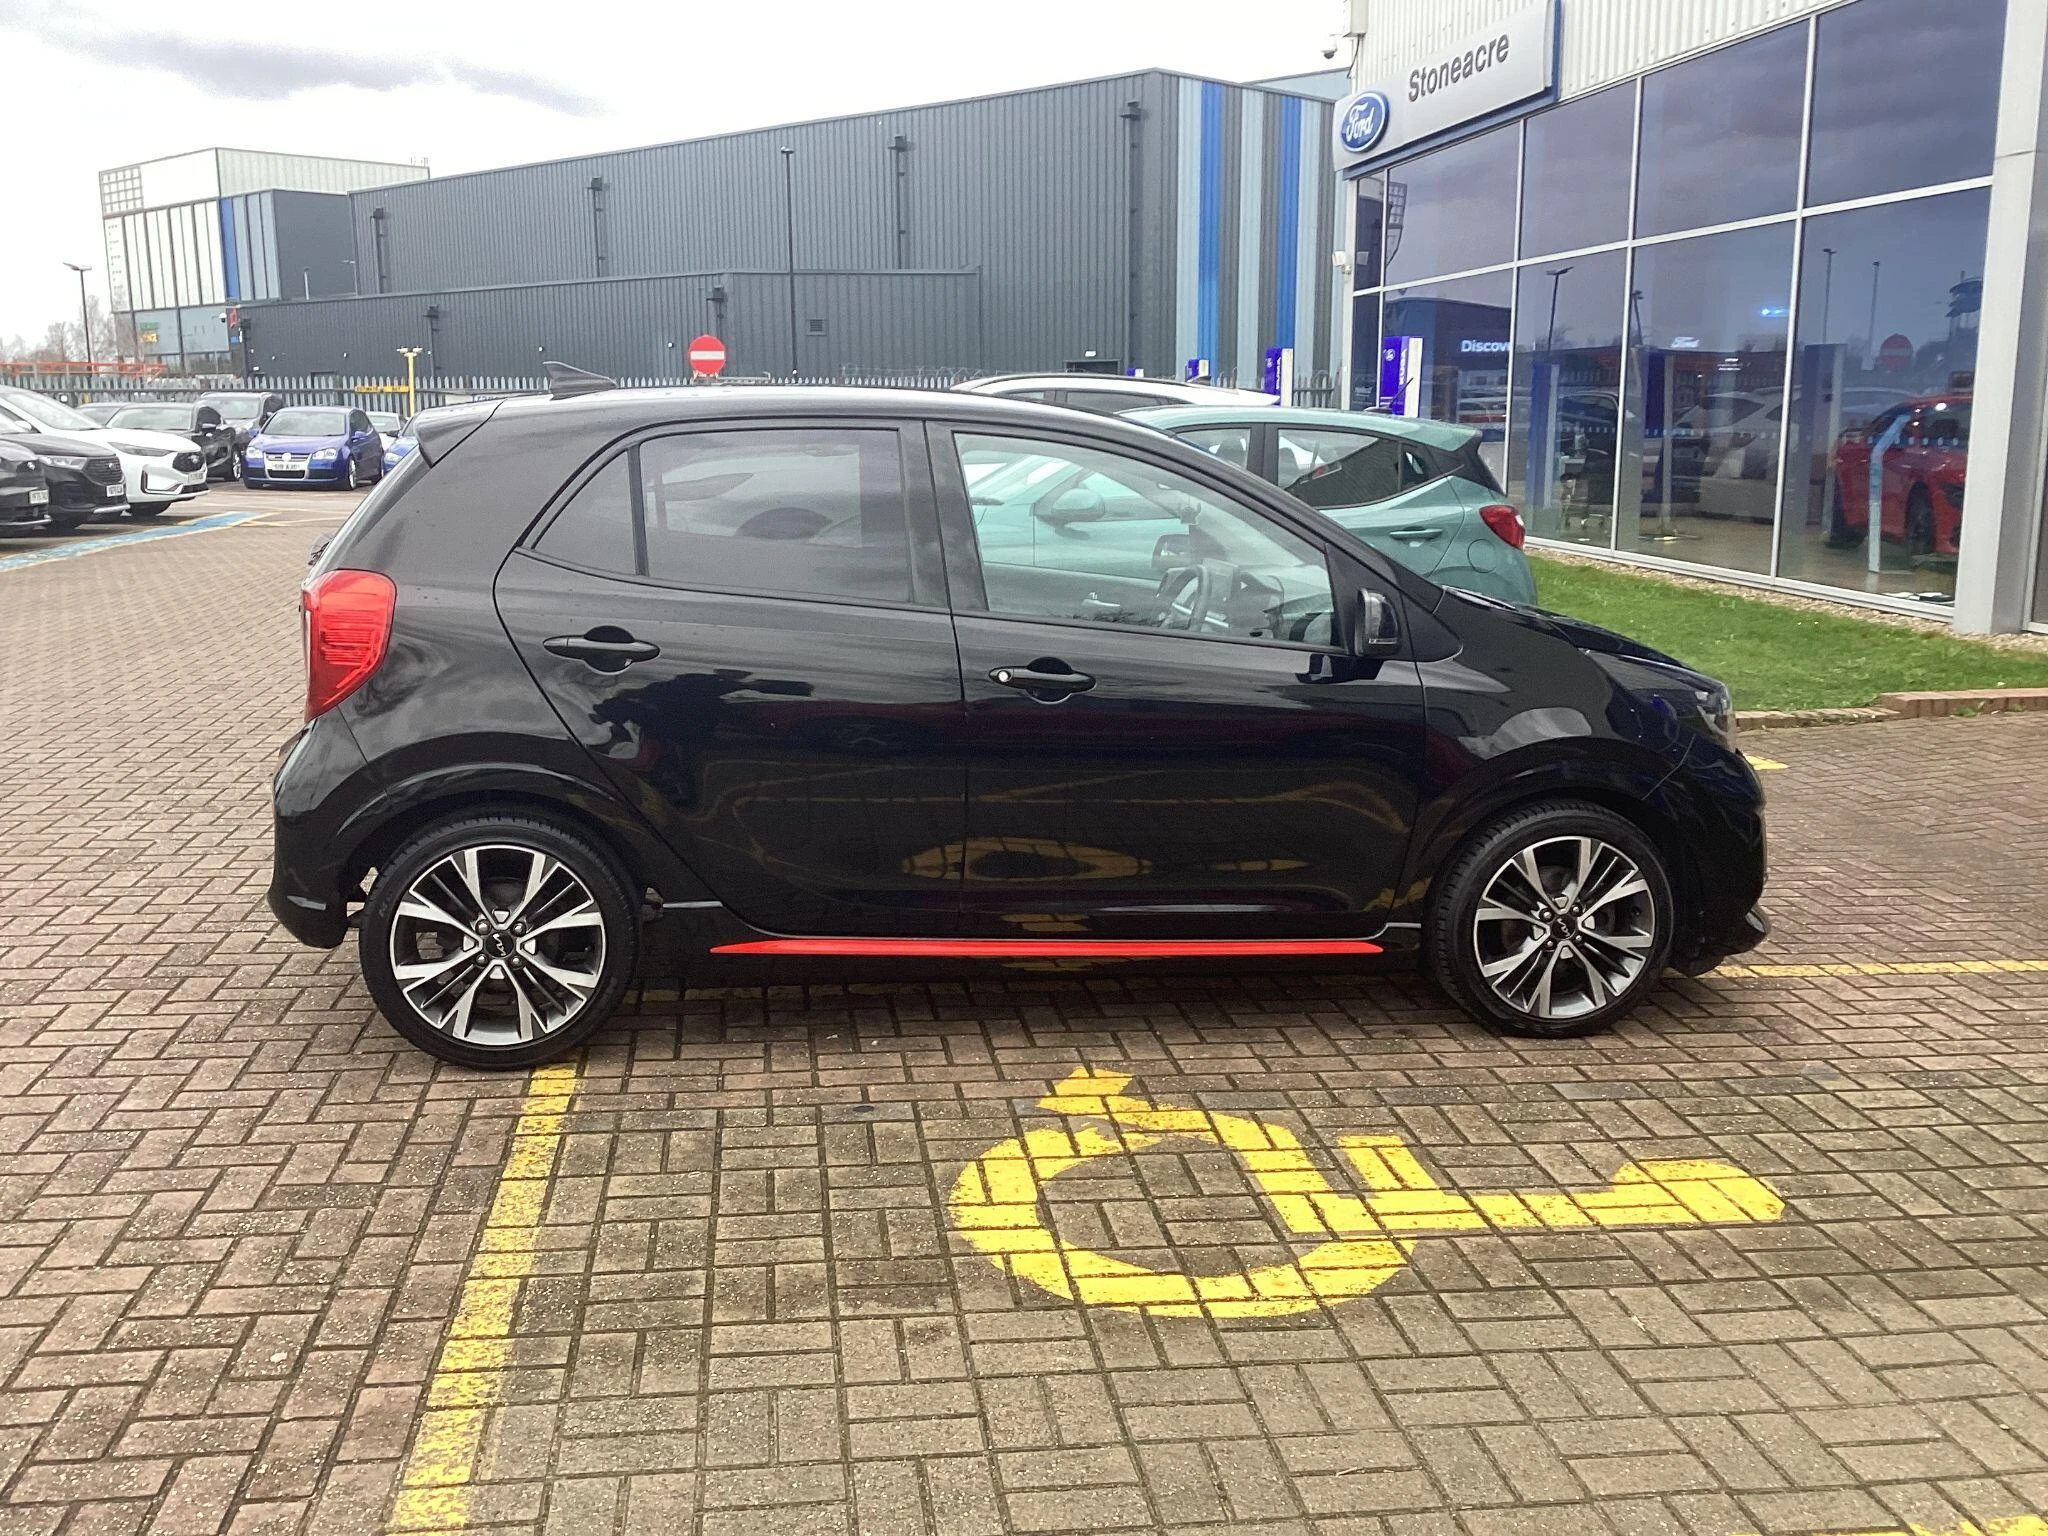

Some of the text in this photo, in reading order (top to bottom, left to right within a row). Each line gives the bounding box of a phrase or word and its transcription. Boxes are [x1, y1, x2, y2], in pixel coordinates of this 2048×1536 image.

[1408, 33, 1510, 103] Stoneacre
[1345, 101, 1375, 143] Ford
[1460, 339, 1510, 353] Discov
